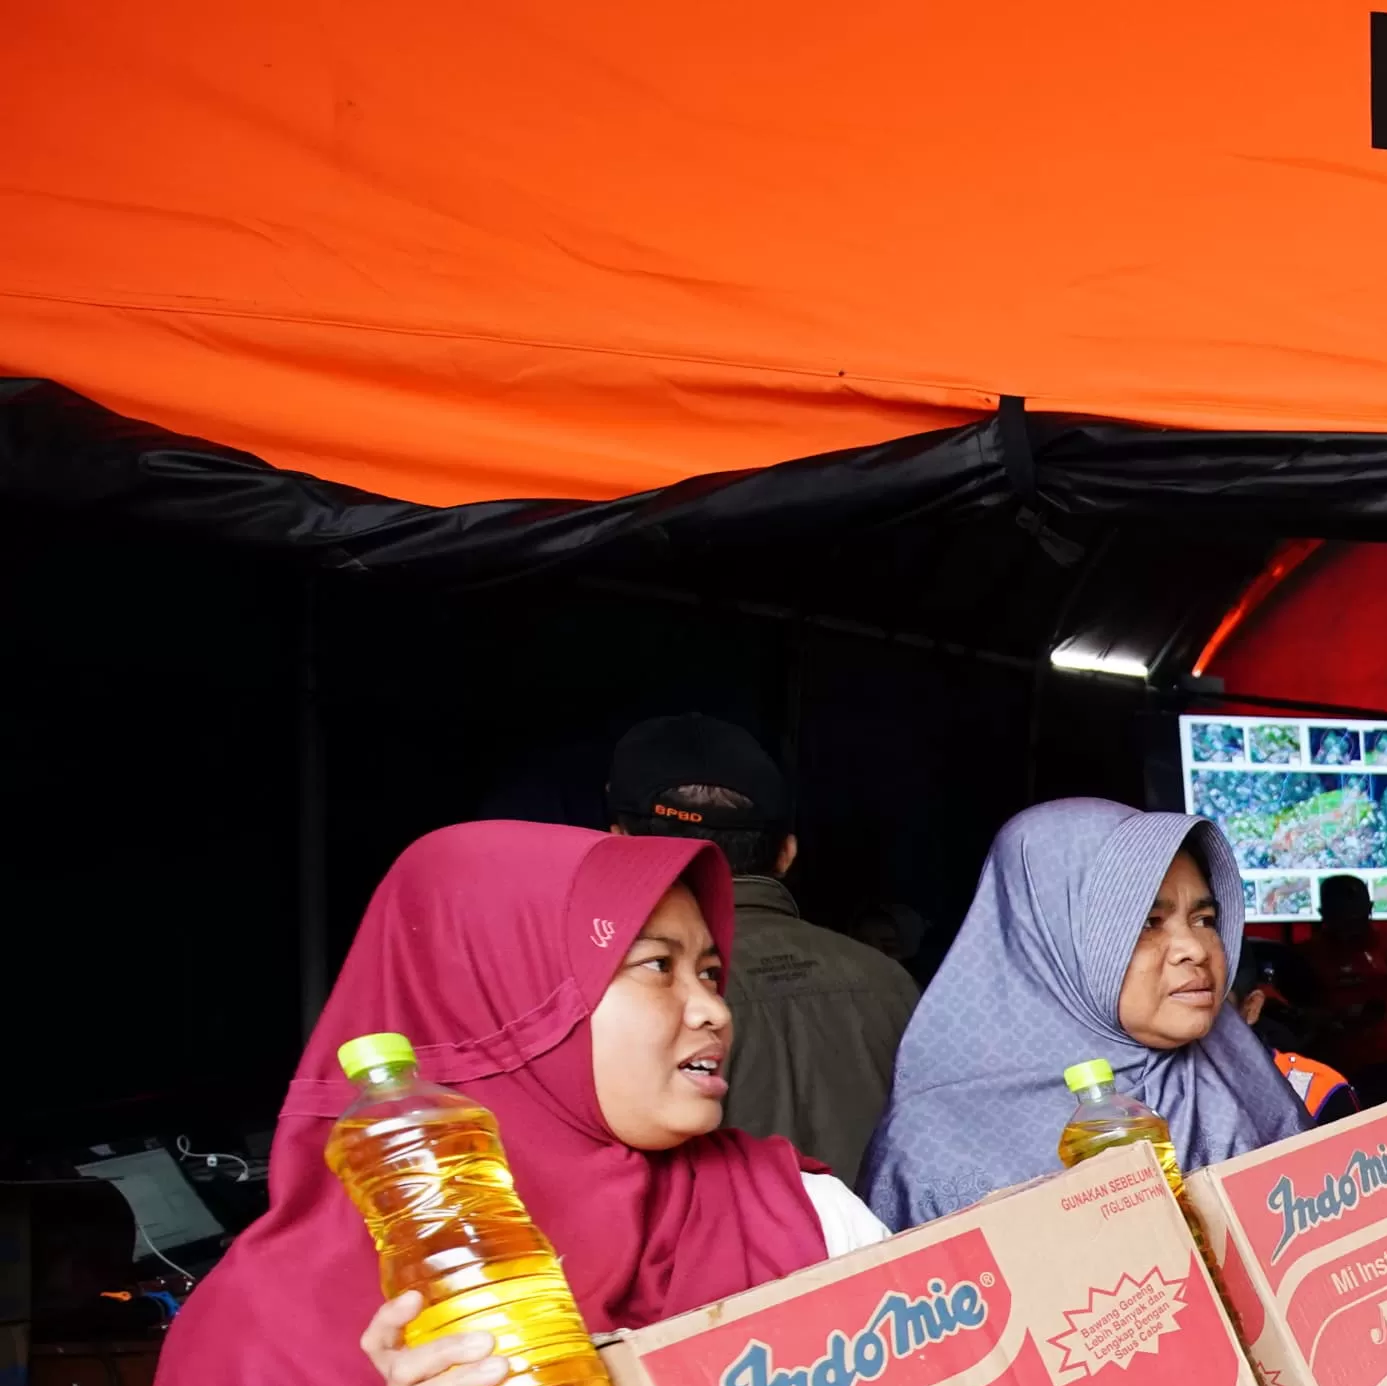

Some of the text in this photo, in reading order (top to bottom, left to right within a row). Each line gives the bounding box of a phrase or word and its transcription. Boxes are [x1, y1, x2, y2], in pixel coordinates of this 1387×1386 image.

[1061, 1169, 1153, 1212] GUNAKAN SEBELUM
[1331, 1268, 1355, 1298] Mi
[1080, 1283, 1155, 1339] Bawang Goreng
[1085, 1289, 1166, 1352] Lebih Banyak dan
[1093, 1301, 1171, 1361] Lengkap Dengan
[1114, 1339, 1140, 1361] Saus
